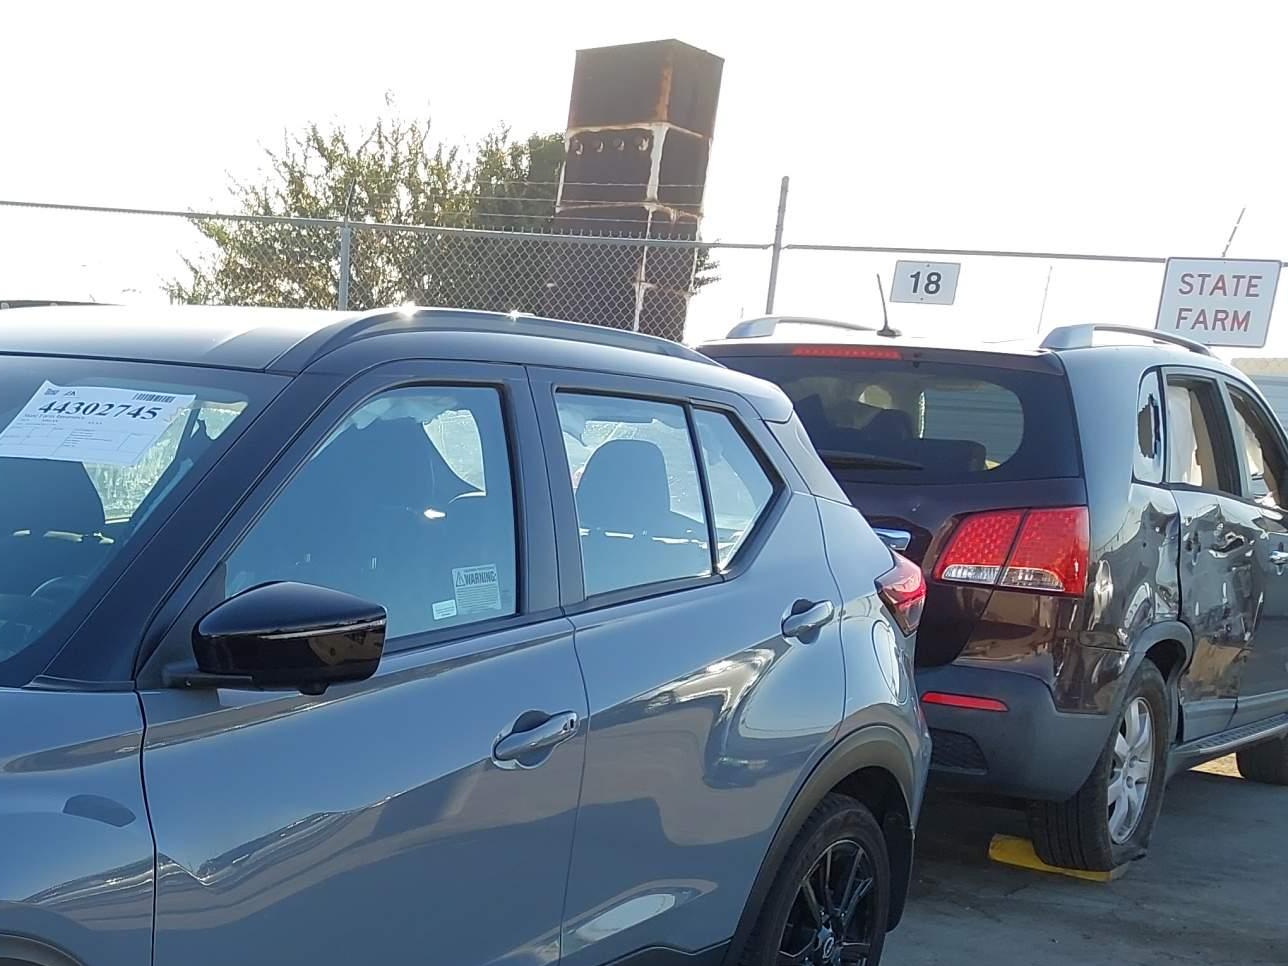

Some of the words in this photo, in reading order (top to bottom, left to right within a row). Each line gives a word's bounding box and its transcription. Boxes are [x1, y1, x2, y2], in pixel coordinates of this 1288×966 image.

[909, 271, 942, 295] 18
[1178, 272, 1263, 298] STATE
[1175, 307, 1252, 332] FARM
[38, 400, 162, 421] 44302745
